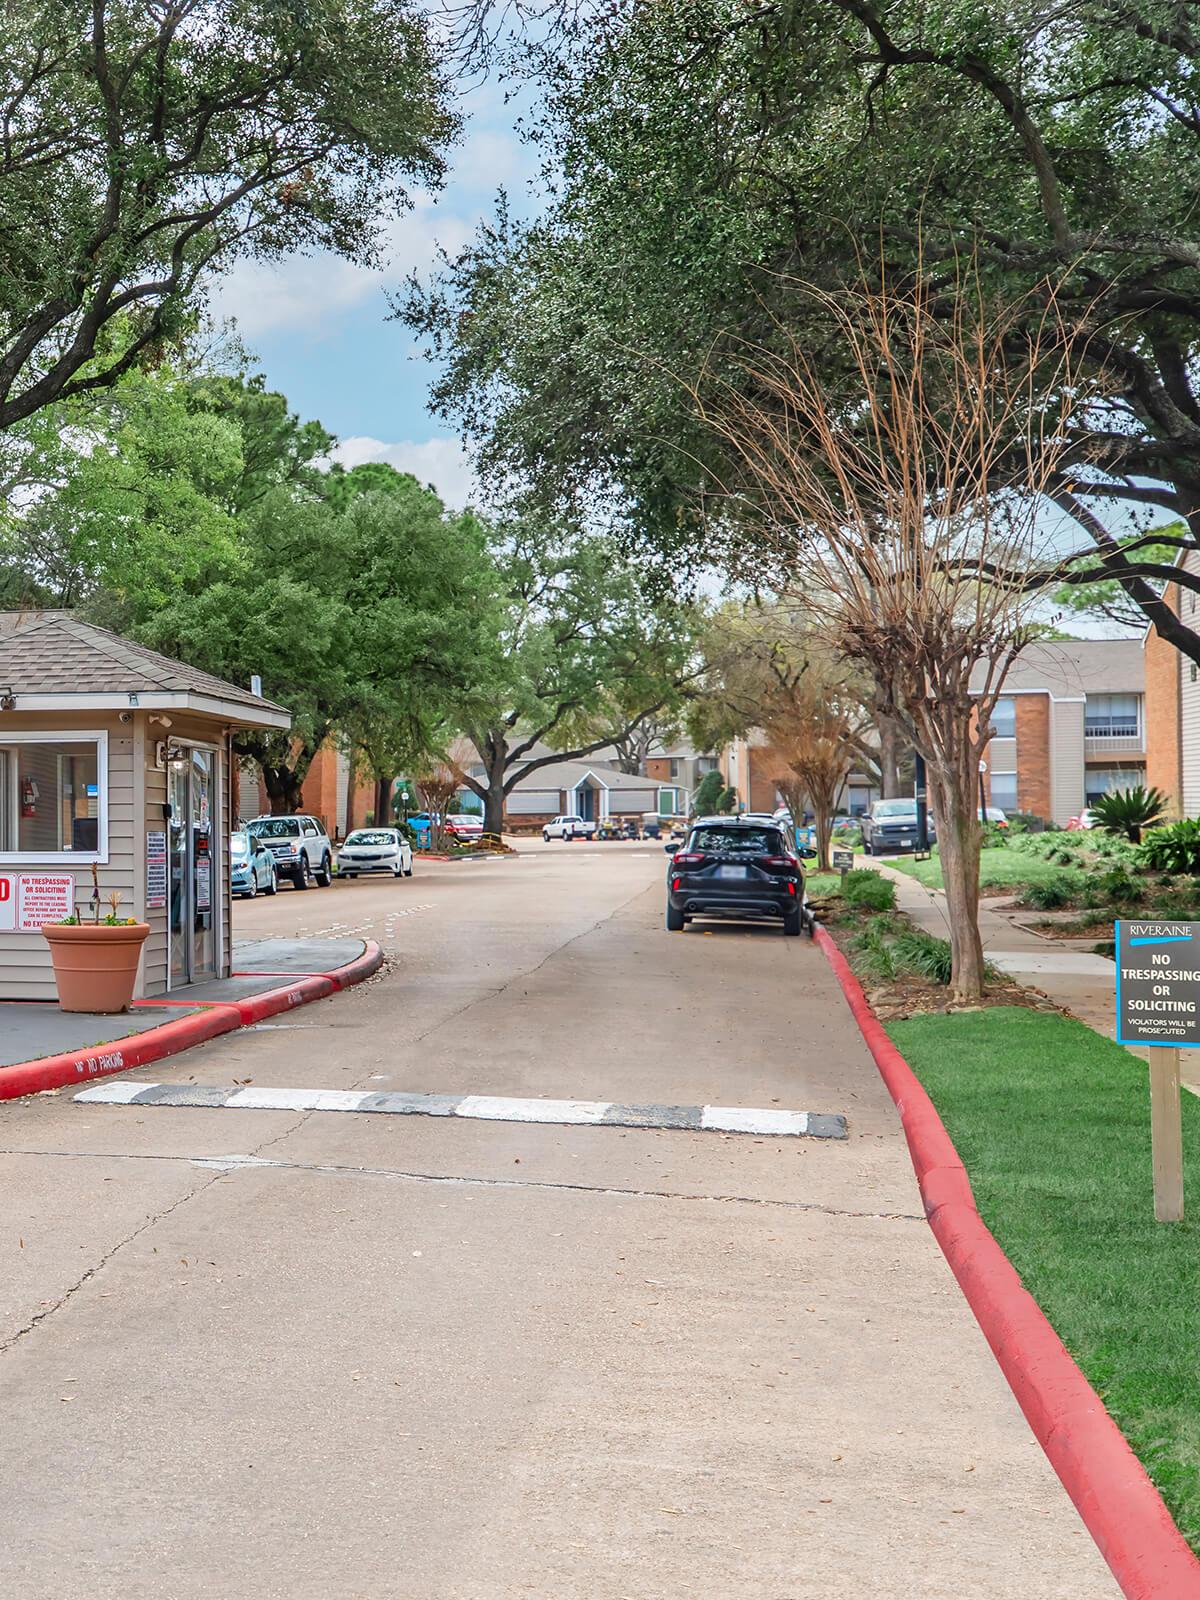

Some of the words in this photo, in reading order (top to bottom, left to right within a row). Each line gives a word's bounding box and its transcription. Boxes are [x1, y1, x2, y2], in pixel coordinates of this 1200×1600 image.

[31, 878, 71, 886] TRESPASSING
[1129, 925, 1193, 937] RIVERAINE
[1151, 954, 1171, 965] NO
[1121, 969, 1200, 981] TRESPASSING
[1152, 986, 1171, 996] OR
[1128, 1000, 1196, 1012] SOLICITING
[1128, 1018, 1167, 1027] VIOLATORS
[86, 1058, 97, 1073] NO
[98, 1052, 124, 1070] PARKING
